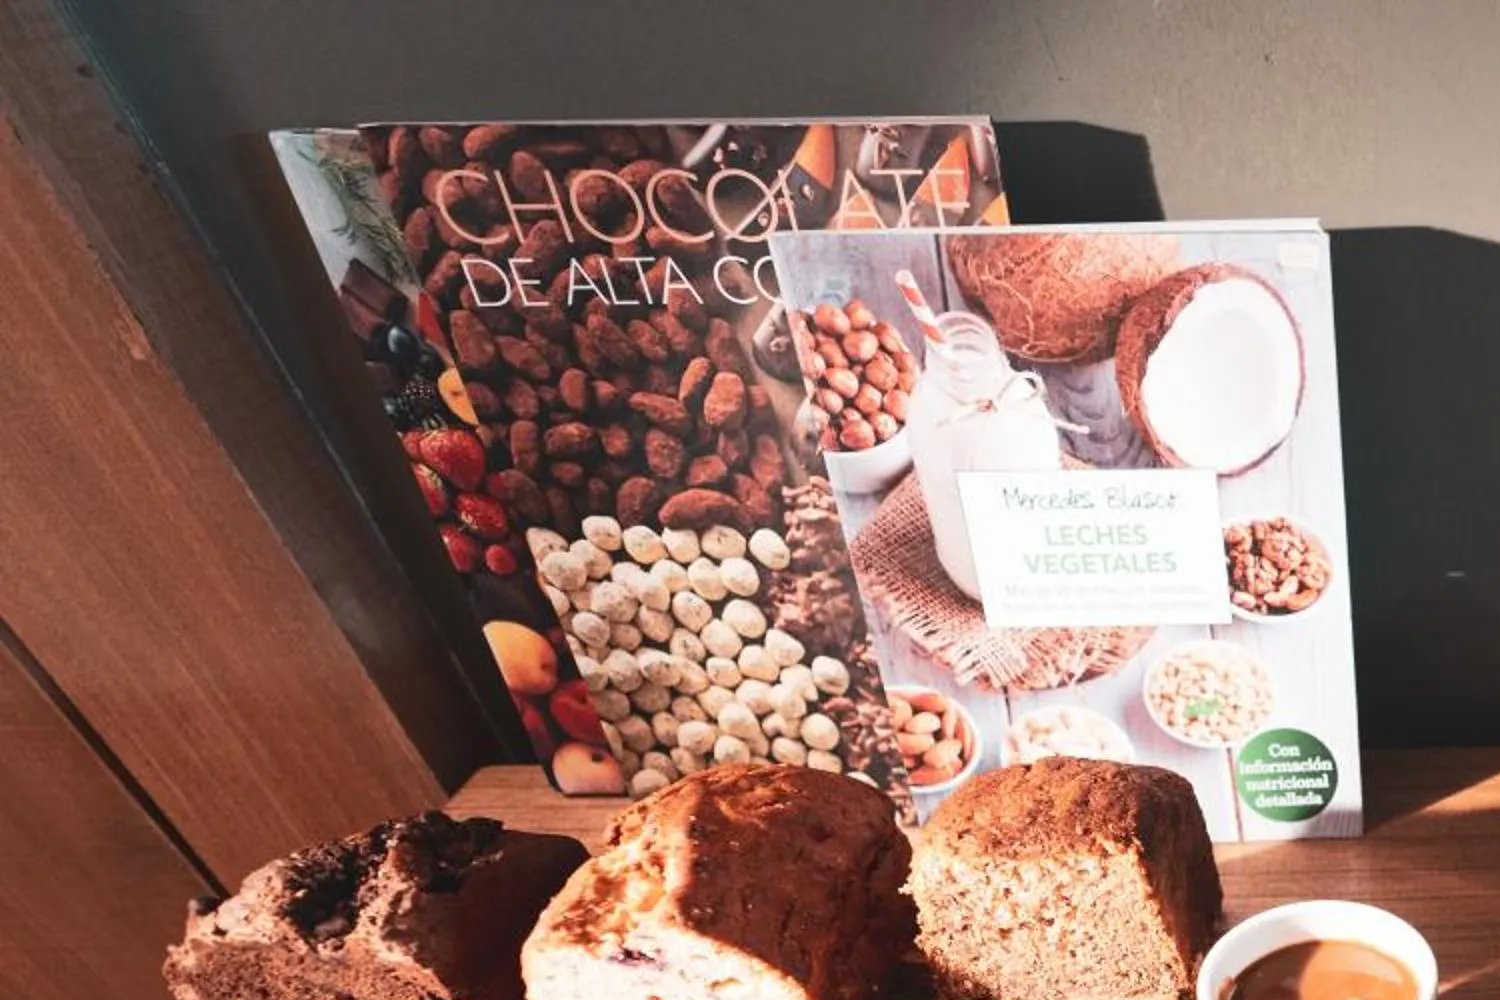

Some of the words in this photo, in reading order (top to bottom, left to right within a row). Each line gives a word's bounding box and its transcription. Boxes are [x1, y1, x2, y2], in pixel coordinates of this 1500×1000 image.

[436, 167, 972, 244] CHOCOLATE
[461, 257, 550, 307] DE
[567, 255, 702, 306] ALTA
[1002, 486, 1095, 511] Mercedes
[1044, 524, 1149, 547] LECHES
[1022, 551, 1178, 575] VEGETALES
[1267, 743, 1301, 758] Con
[1239, 756, 1334, 774] información
[1245, 773, 1330, 791] nutricional
[1255, 791, 1324, 809] detallada
